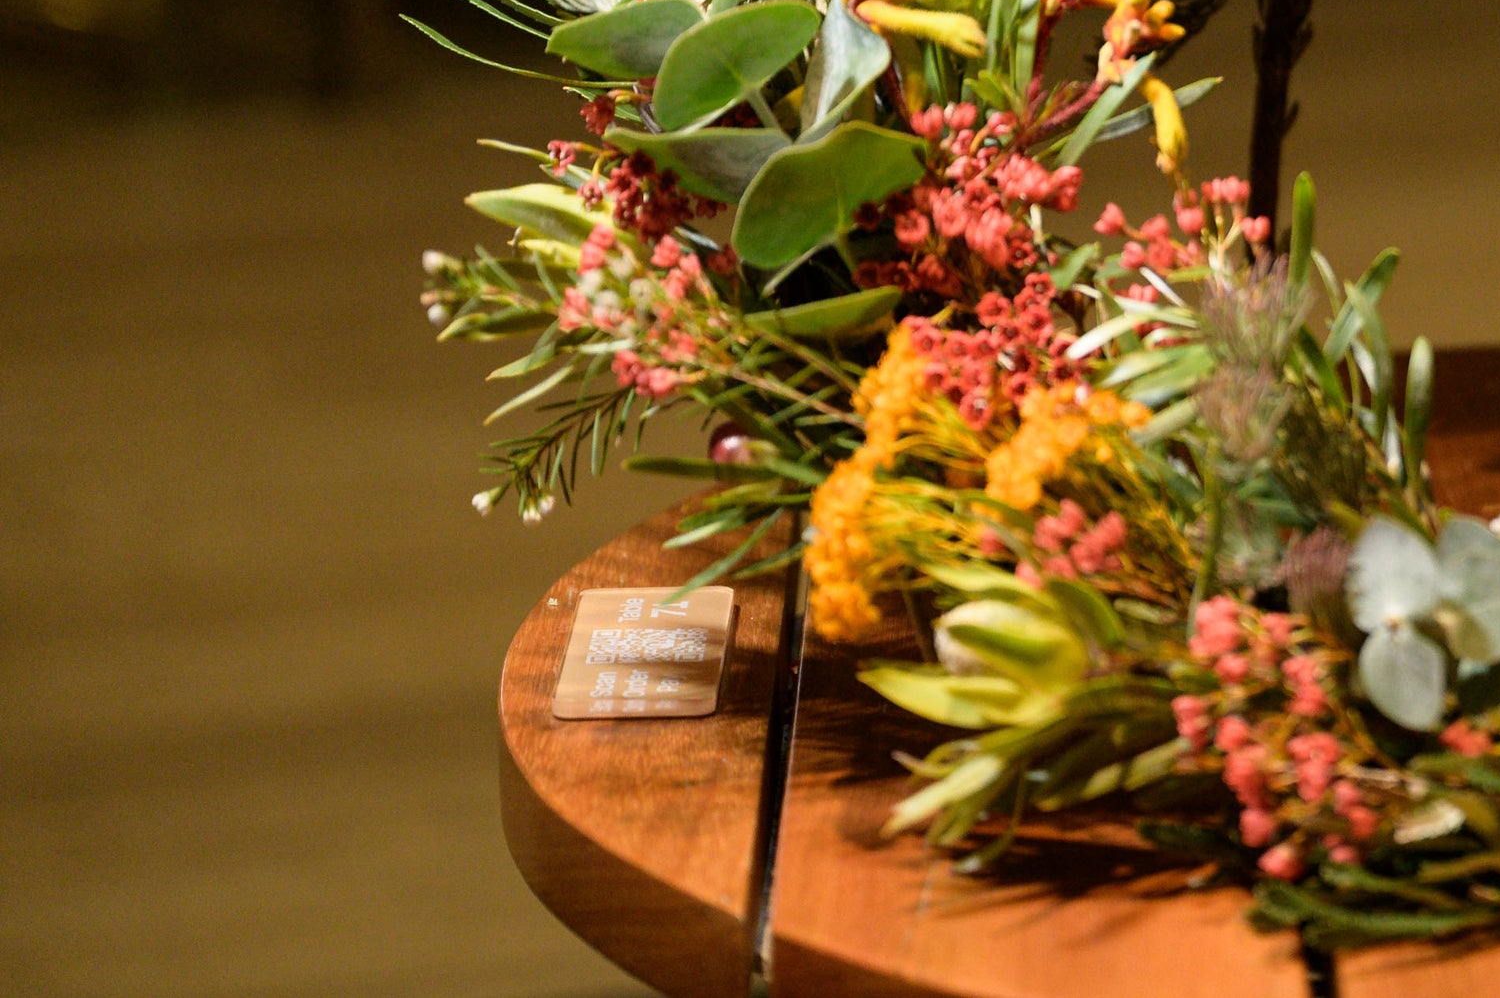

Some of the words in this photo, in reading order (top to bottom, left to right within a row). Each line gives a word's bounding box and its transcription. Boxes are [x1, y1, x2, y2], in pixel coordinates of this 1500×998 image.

[618, 598, 645, 623] Table
[651, 600, 690, 618] 71
[589, 671, 618, 698] Scan
[621, 669, 649, 698] Order
